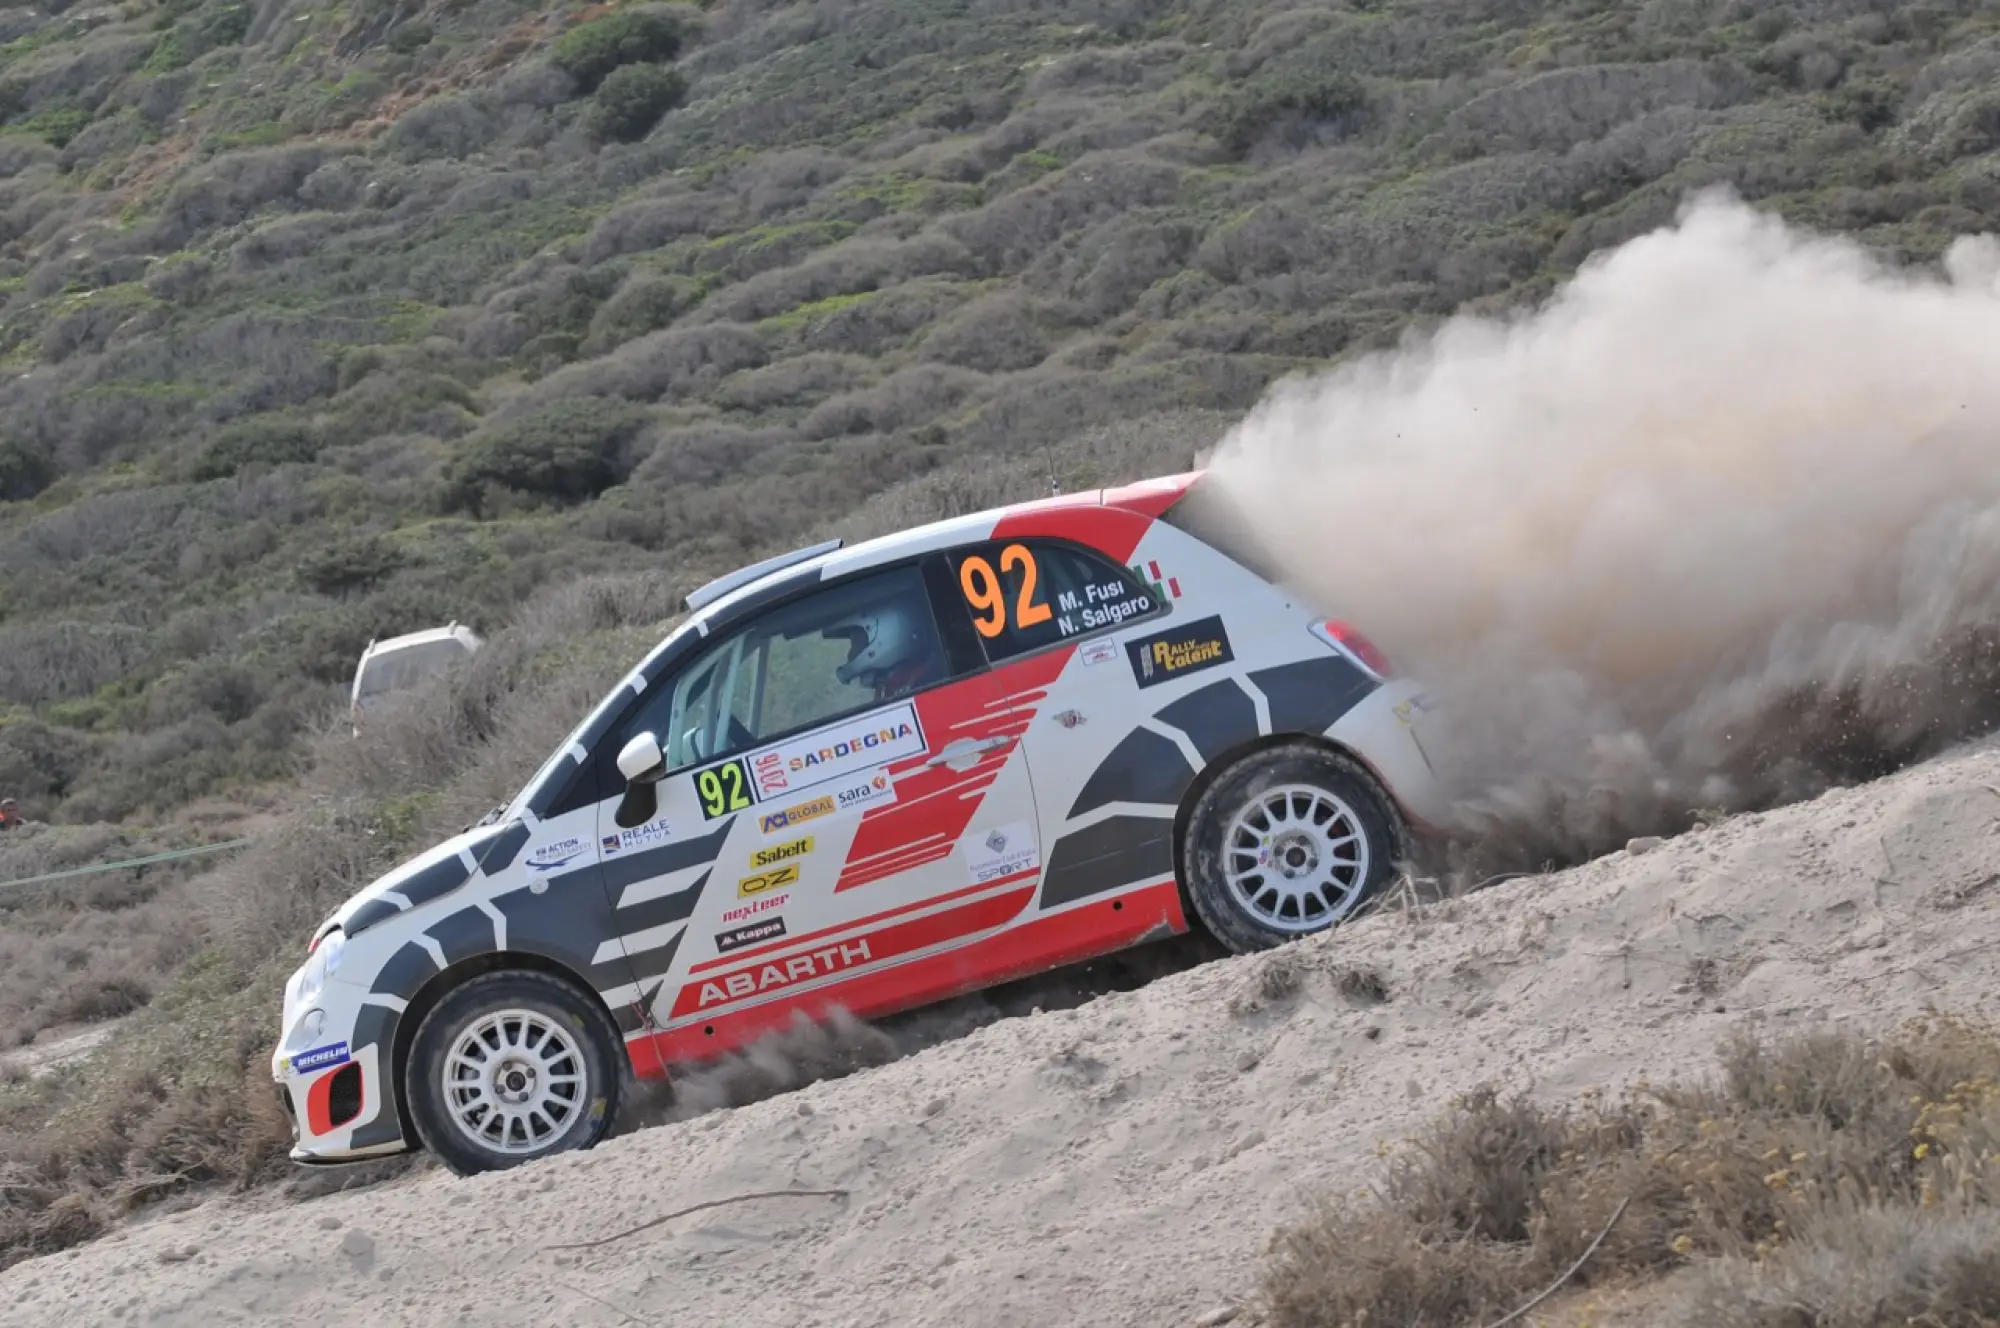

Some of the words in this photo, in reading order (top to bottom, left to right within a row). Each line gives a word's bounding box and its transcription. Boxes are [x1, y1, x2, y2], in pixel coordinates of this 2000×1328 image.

[960, 543, 1052, 638] 92
[1058, 594, 1083, 612] M.
[1058, 618, 1080, 636] N.
[1083, 595, 1150, 630] Salgaro
[789, 723, 912, 772] SARDEGNA
[756, 752, 788, 793] 2016
[699, 763, 751, 817] 92
[838, 783, 871, 803] sara
[788, 800, 834, 822] GLOBAL
[622, 819, 669, 840] REALE
[624, 830, 671, 848] MUTUA
[756, 839, 808, 865] Sabelt
[977, 857, 1032, 882] SPORT
[722, 893, 790, 922] nexteer
[736, 923, 781, 941] Kappa
[697, 939, 872, 1007] ABARTH
[297, 1047, 347, 1067] MICHELIN
